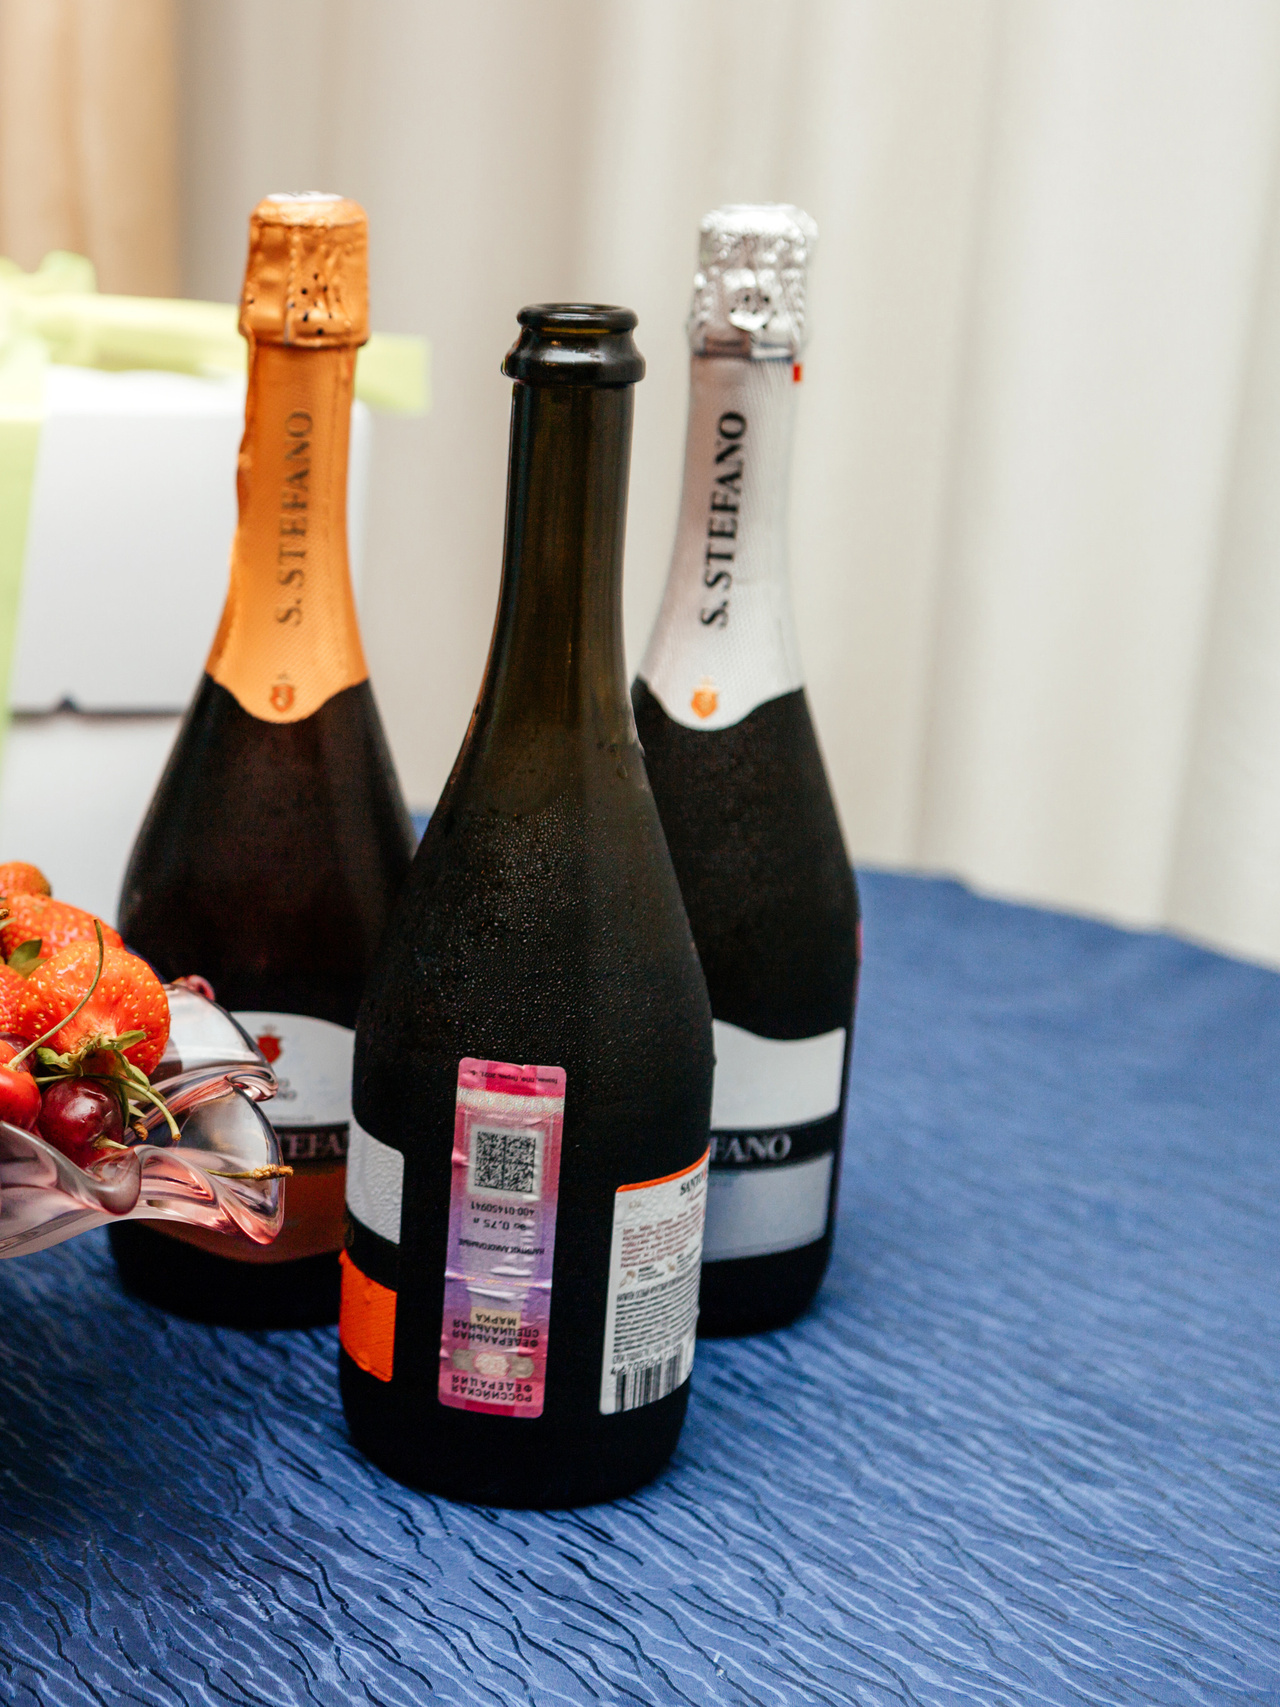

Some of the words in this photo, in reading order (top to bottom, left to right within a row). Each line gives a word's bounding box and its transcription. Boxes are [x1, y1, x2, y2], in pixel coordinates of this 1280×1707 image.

[277, 410, 314, 589] STEFANO
[704, 410, 747, 591] STEFANO
[276, 598, 303, 627] S.
[699, 599, 729, 629] S.
[453, 1319, 539, 1338] СПЕЦИАЛЬНАЯ
[475, 1313, 517, 1327] МАРКА
[452, 1329, 539, 1348] ФЕДЕРАЛЬНАЯ
[451, 1384, 533, 1403] РОССИЙСКАЯ
[452, 1375, 533, 1393] ФЕДЕРАЦИЯ
